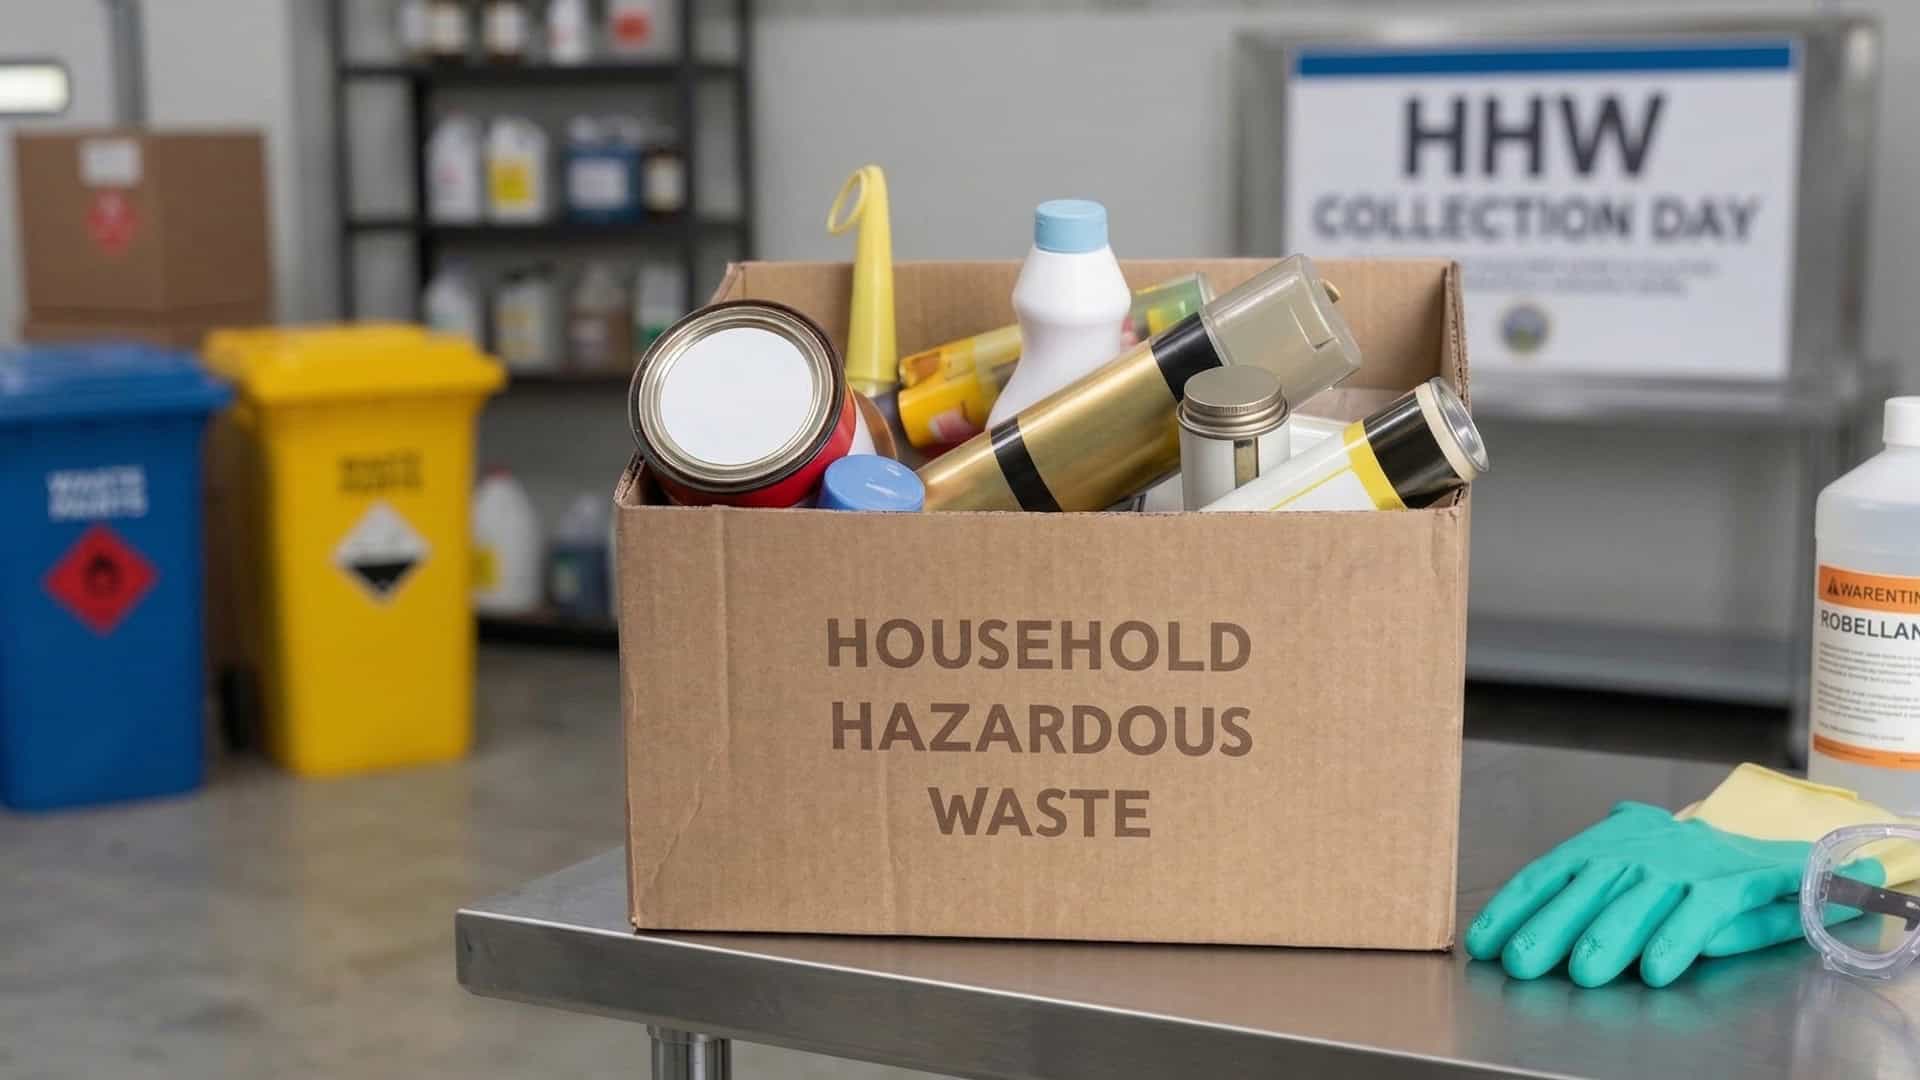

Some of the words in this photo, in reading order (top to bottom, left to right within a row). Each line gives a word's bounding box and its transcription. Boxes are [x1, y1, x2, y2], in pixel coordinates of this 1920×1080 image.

[1403, 92, 1666, 178] HHW
[1313, 197, 1632, 242] COLLECTION
[1651, 195, 1759, 241] DAY
[827, 618, 1252, 672] HOUSEHOLD
[831, 701, 1254, 757] HAZARDOUS
[928, 787, 1151, 838] WASTE
